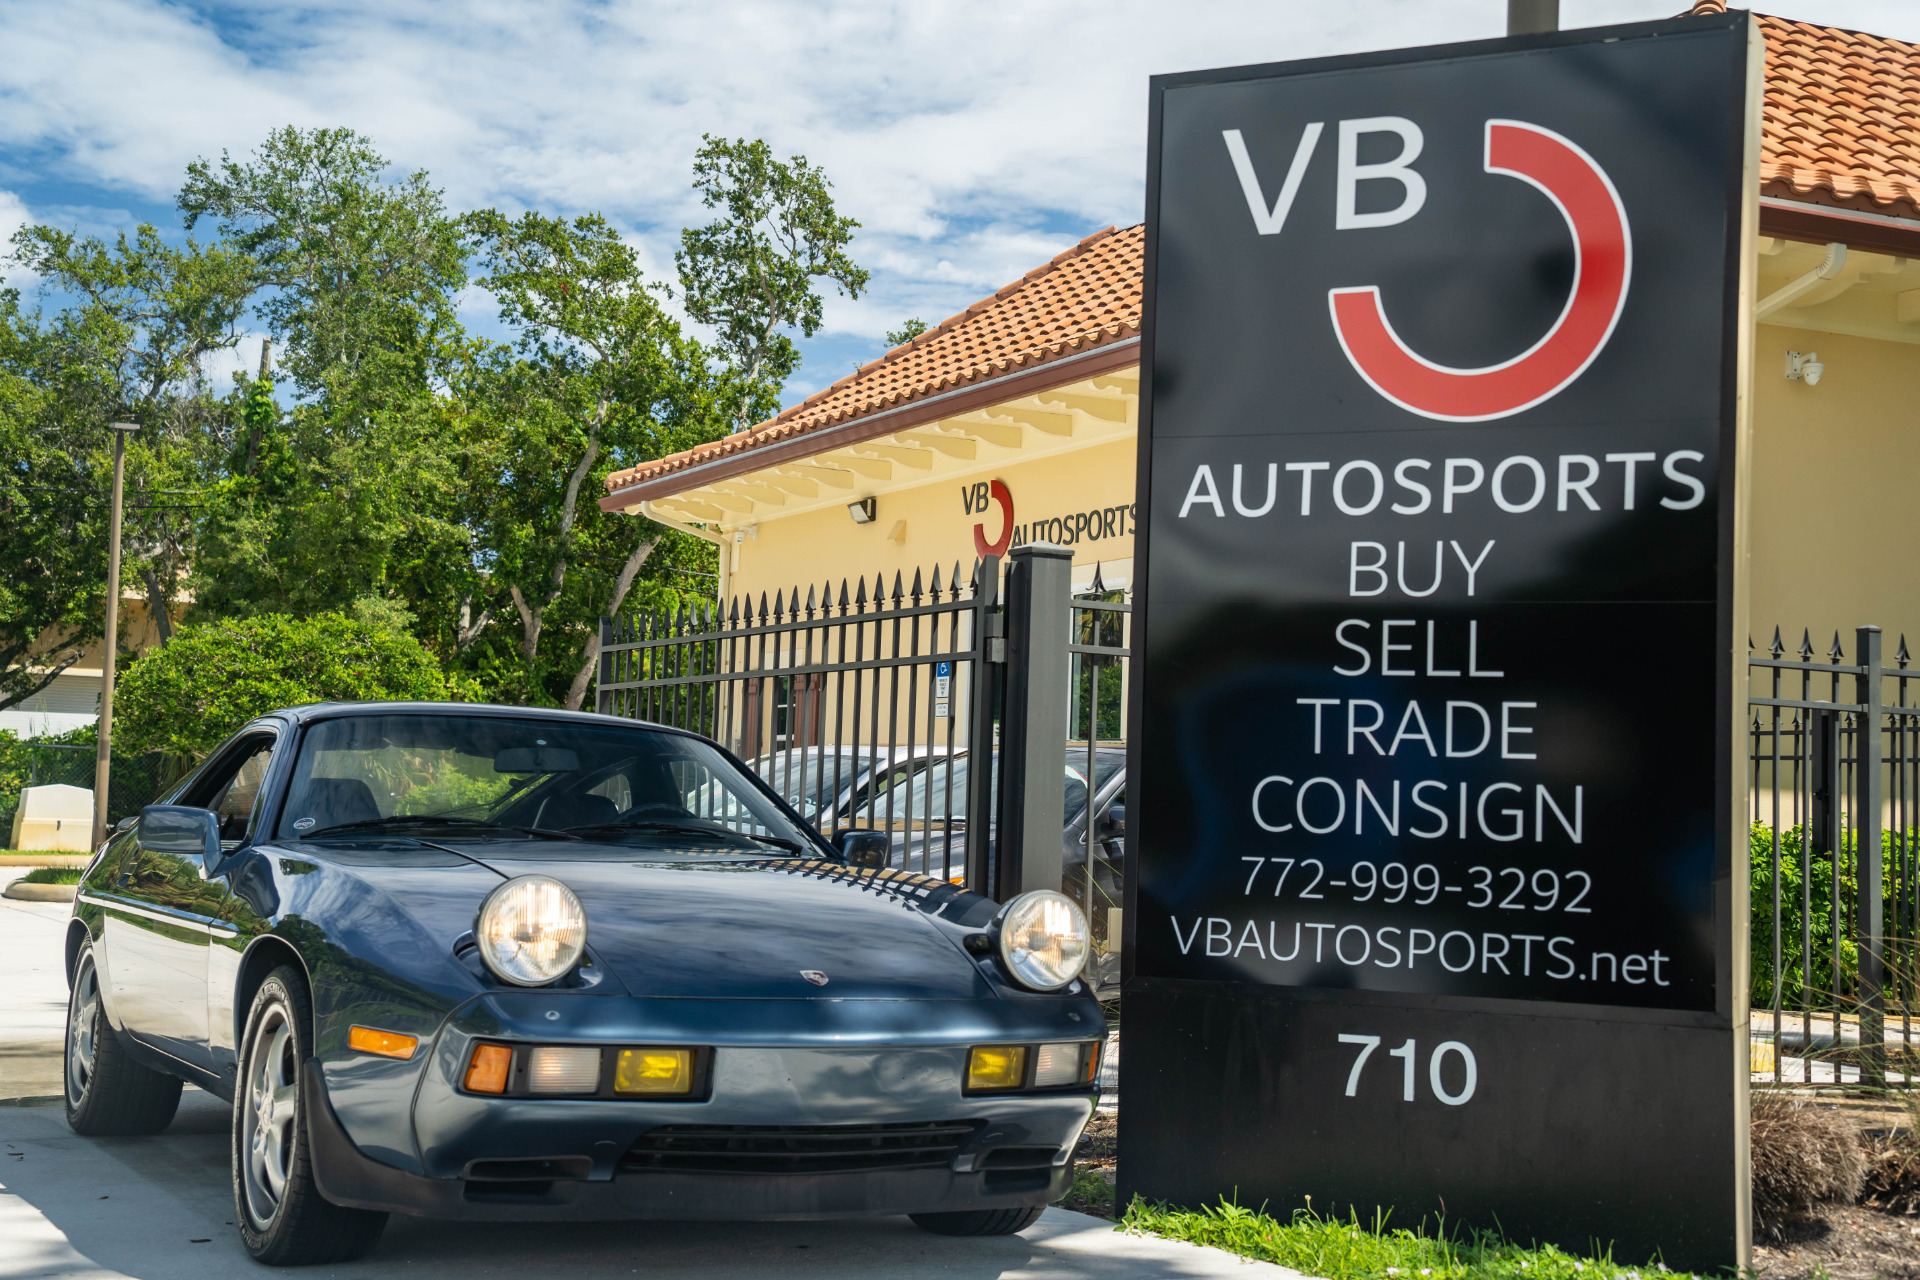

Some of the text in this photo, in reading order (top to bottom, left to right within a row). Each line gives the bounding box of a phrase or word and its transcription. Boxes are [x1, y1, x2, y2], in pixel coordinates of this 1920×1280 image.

[1222, 116, 1427, 236] VB
[962, 481, 989, 516] VB
[1178, 450, 1705, 518] AUTOSPORTS
[1348, 539, 1496, 598] BUY
[1333, 618, 1505, 678] SELL
[1296, 698, 1537, 760] TRADE
[1251, 775, 1583, 844] CONSIGN
[1241, 856, 1592, 913] 772-999-3292
[1170, 915, 1671, 987] VBAUTOSPORTS.net
[1338, 1033, 1478, 1107] 710
